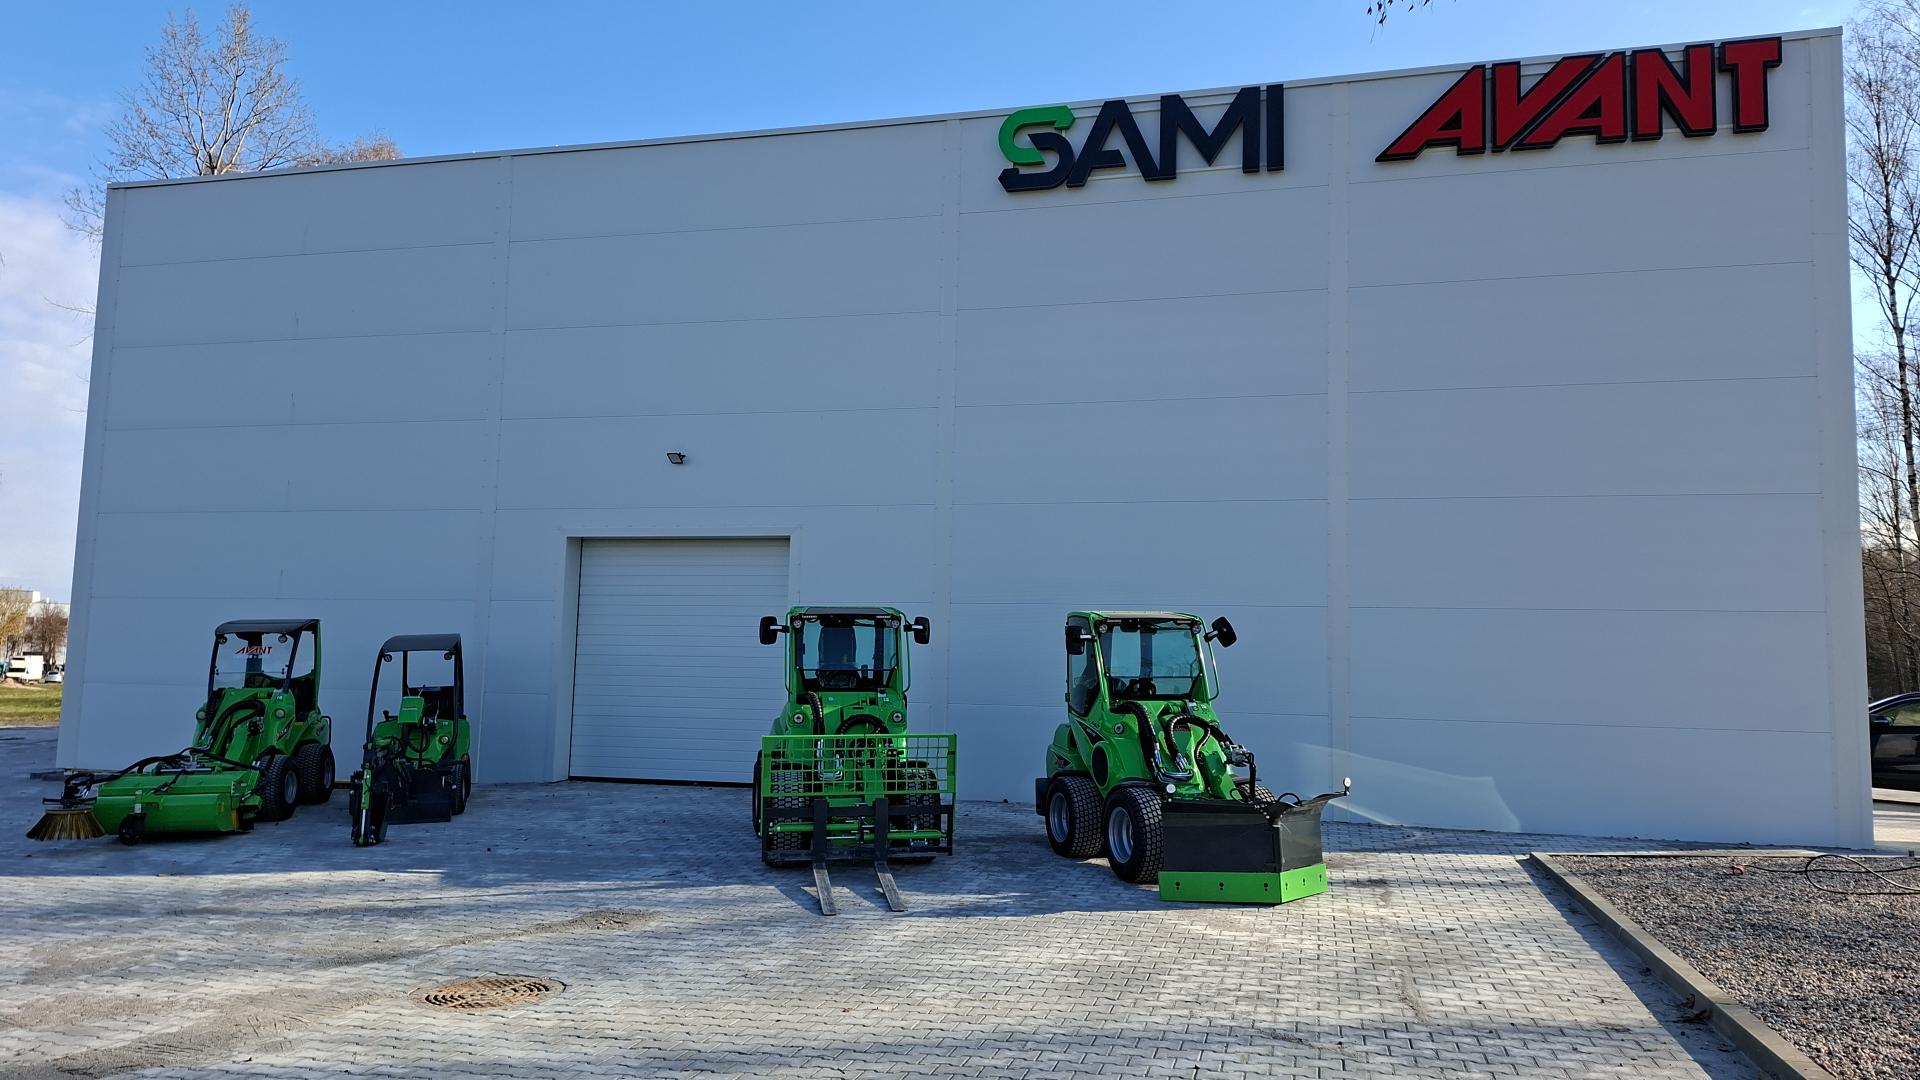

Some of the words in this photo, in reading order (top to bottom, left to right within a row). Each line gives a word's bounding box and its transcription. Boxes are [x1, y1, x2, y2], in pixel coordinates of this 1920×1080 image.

[998, 83, 1285, 193] SAMI
[1375, 36, 1783, 162] AVANT
[235, 646, 273, 656] AVANT
